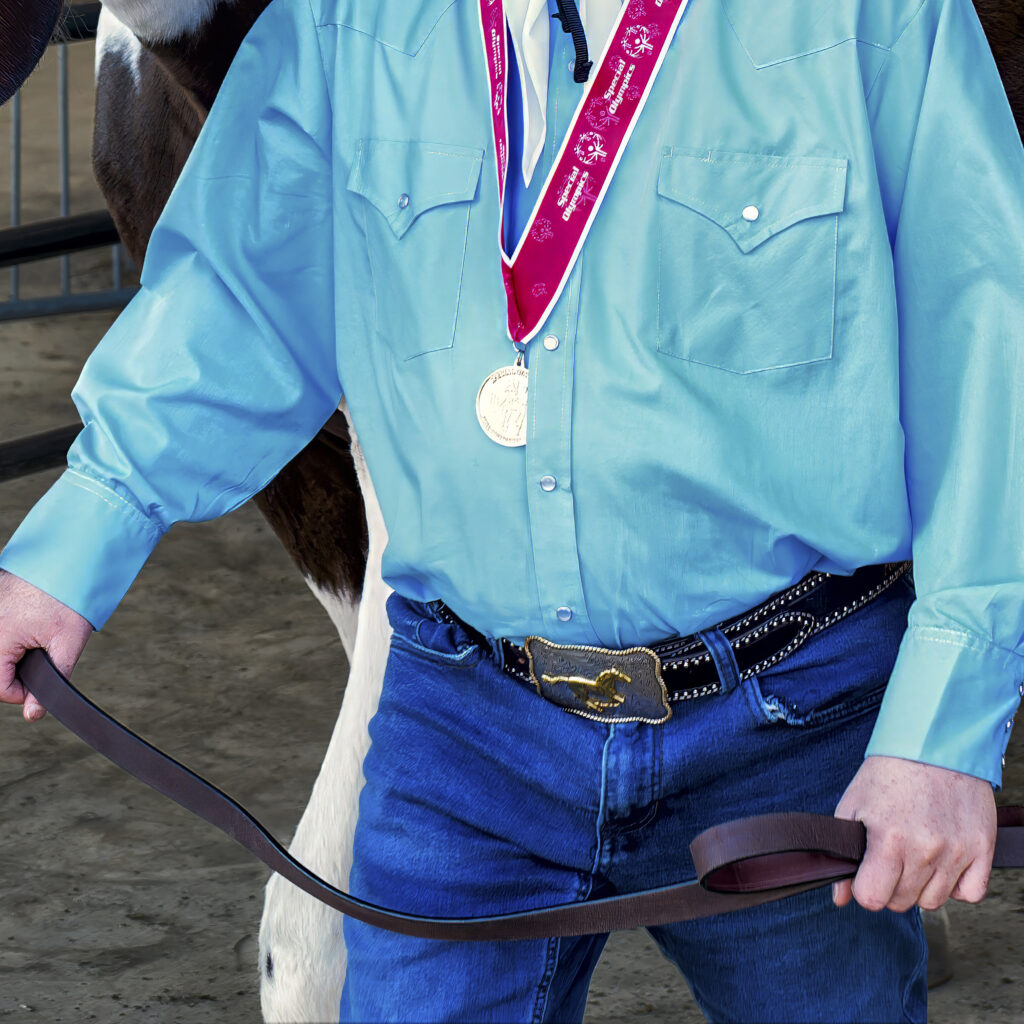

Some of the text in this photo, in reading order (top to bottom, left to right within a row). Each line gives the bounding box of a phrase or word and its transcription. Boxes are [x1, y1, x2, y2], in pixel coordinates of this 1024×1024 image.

[603, 59, 625, 102] Special
[608, 63, 636, 115] Olympics
[557, 166, 580, 209] Special
[561, 170, 589, 222] Olympics
